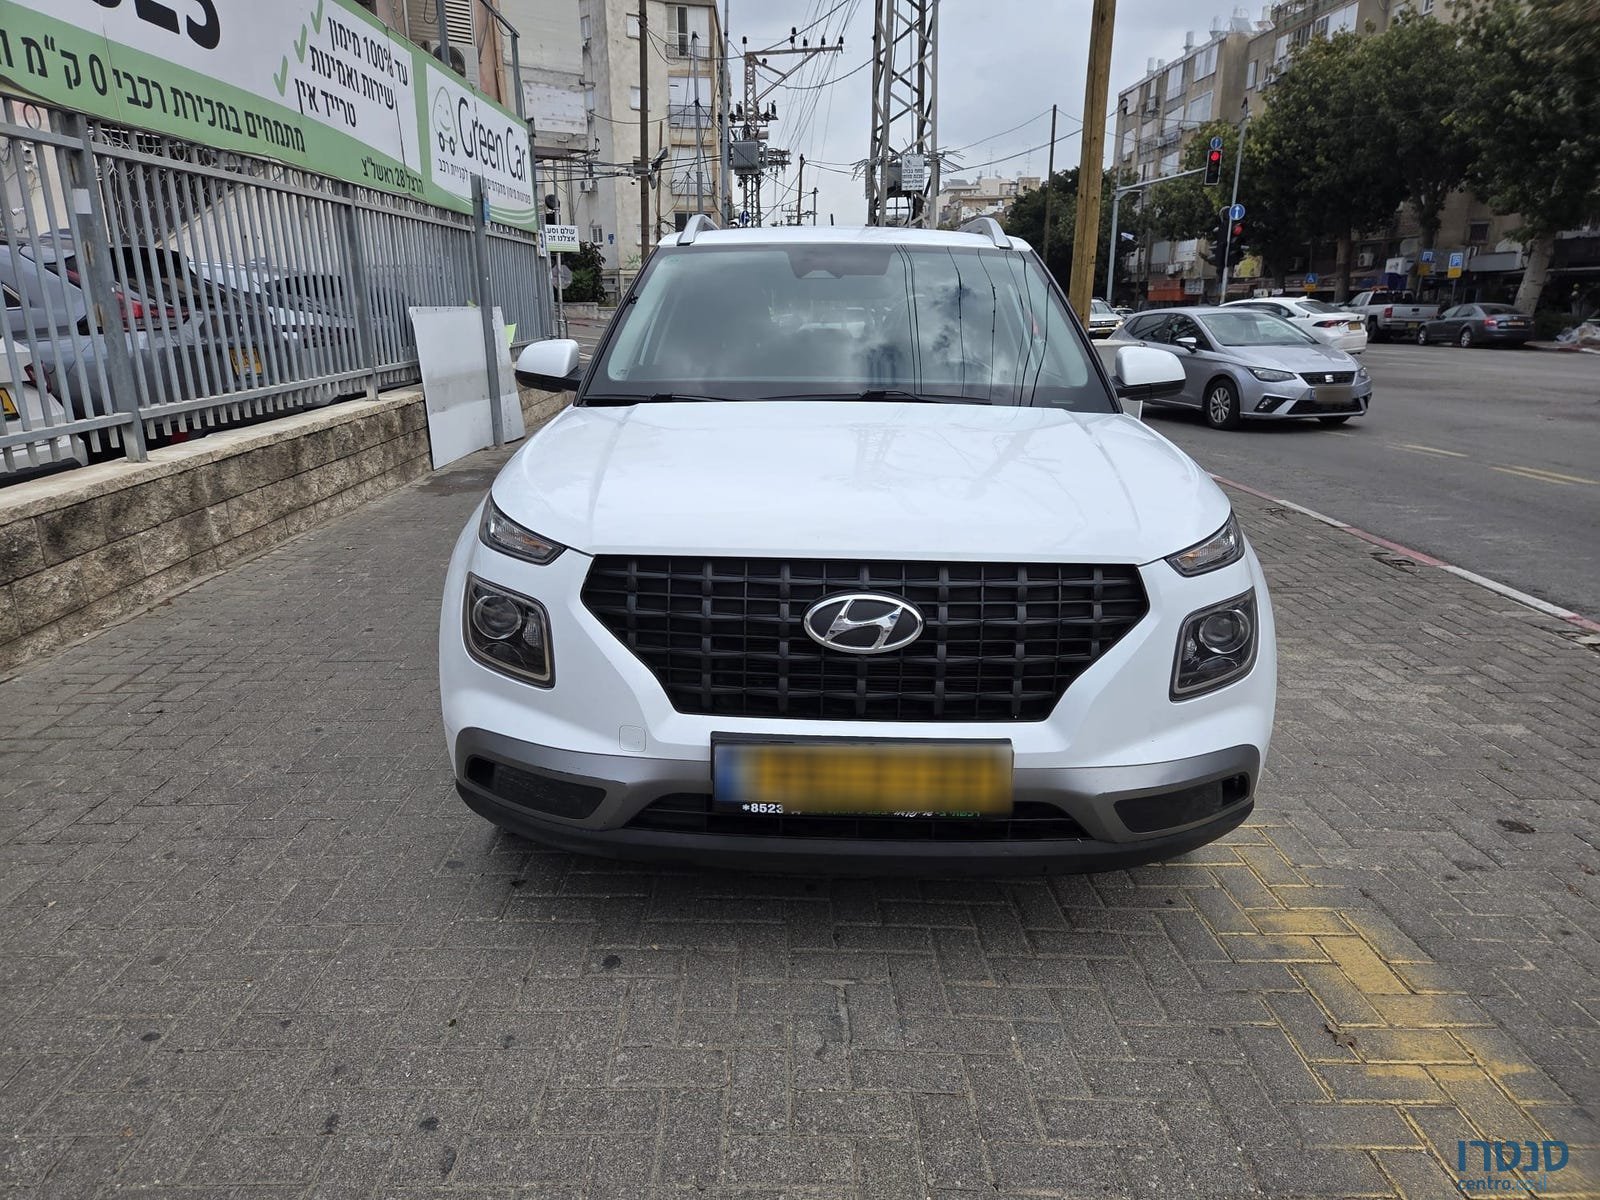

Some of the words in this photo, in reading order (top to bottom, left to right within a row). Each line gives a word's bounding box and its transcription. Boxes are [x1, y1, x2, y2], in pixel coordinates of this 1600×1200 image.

[327, 17, 362, 59] מימון
[363, 36, 395, 78] 100%
[309, 45, 360, 93] ואמינות
[394, 59, 409, 87] עד
[112, 68, 168, 114] רכבי
[170, 86, 243, 135] במכירת
[295, 78, 319, 115] אין
[320, 90, 357, 128] טרייד
[361, 73, 395, 111] שירות
[243, 110, 306, 153] מתמחים
[458, 96, 506, 173] Green
[505, 126, 527, 183] Car
[394, 166, 405, 188] 28
[405, 169, 425, 195] הרצל
[560, 227, 575, 235] שלם
